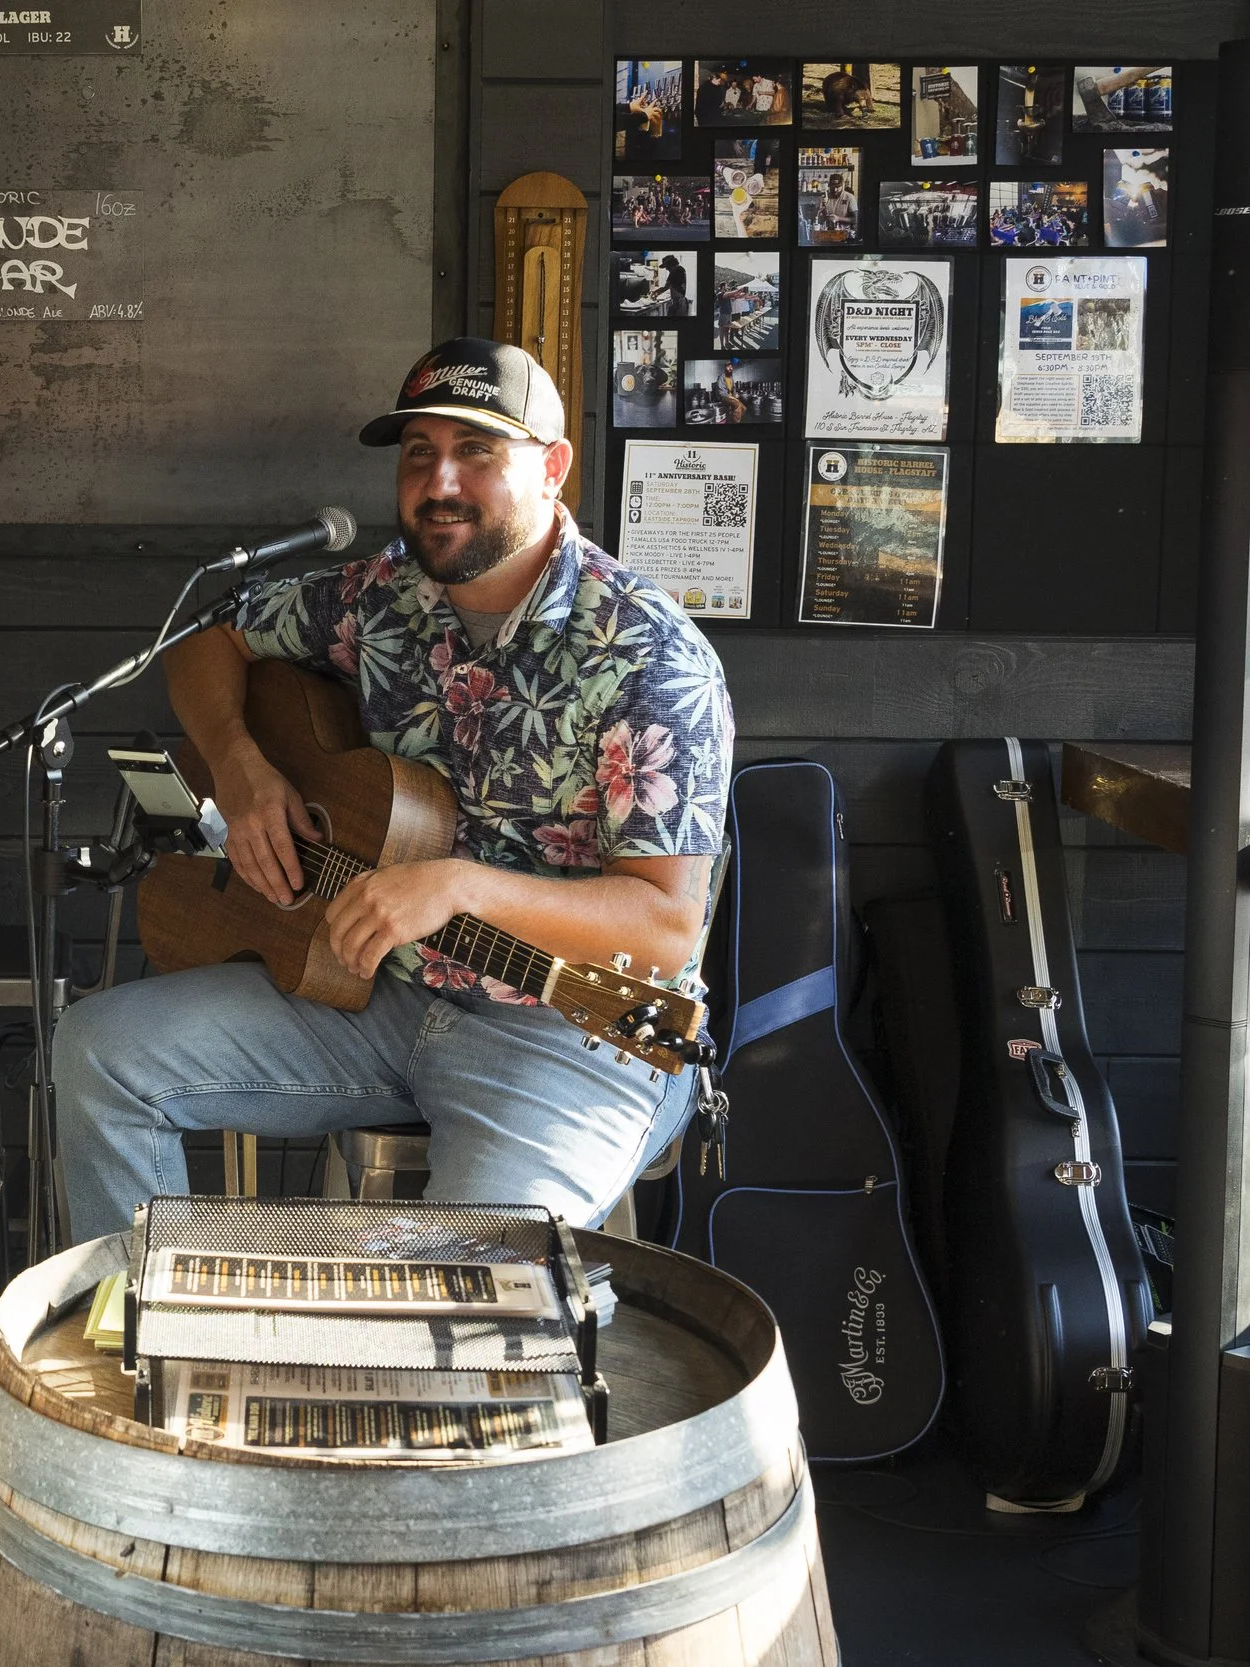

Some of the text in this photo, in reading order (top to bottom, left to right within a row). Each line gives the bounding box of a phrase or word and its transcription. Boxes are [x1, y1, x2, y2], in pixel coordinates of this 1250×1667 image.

[28, 32, 52, 43] IBU:
[55, 31, 72, 43] 22
[846, 306, 914, 317] D&D NIGHT
[1035, 353, 1088, 361] SEPTEMBER
[1037, 364, 1068, 372] 6:30PM
[420, 364, 488, 388] Miller
[448, 378, 501, 396] GENUINE
[452, 386, 492, 402] DRAFT
[673, 458, 706, 469] Historic
[857, 458, 935, 469] HISTORIC BARREL
[854, 466, 937, 477] HOUSE FLAGSTAFF
[657, 472, 712, 481] ANNIVERSARY
[820, 509, 849, 518] Monday
[820, 525, 850, 534] Tuesday
[818, 542, 859, 551] Wednesday
[817, 557, 851, 566] Thursday
[816, 573, 840, 582] Friday
[815, 589, 849, 598] Saturday
[813, 604, 841, 613] Sunday
[876, 1303, 886, 1364] EST. 1833
